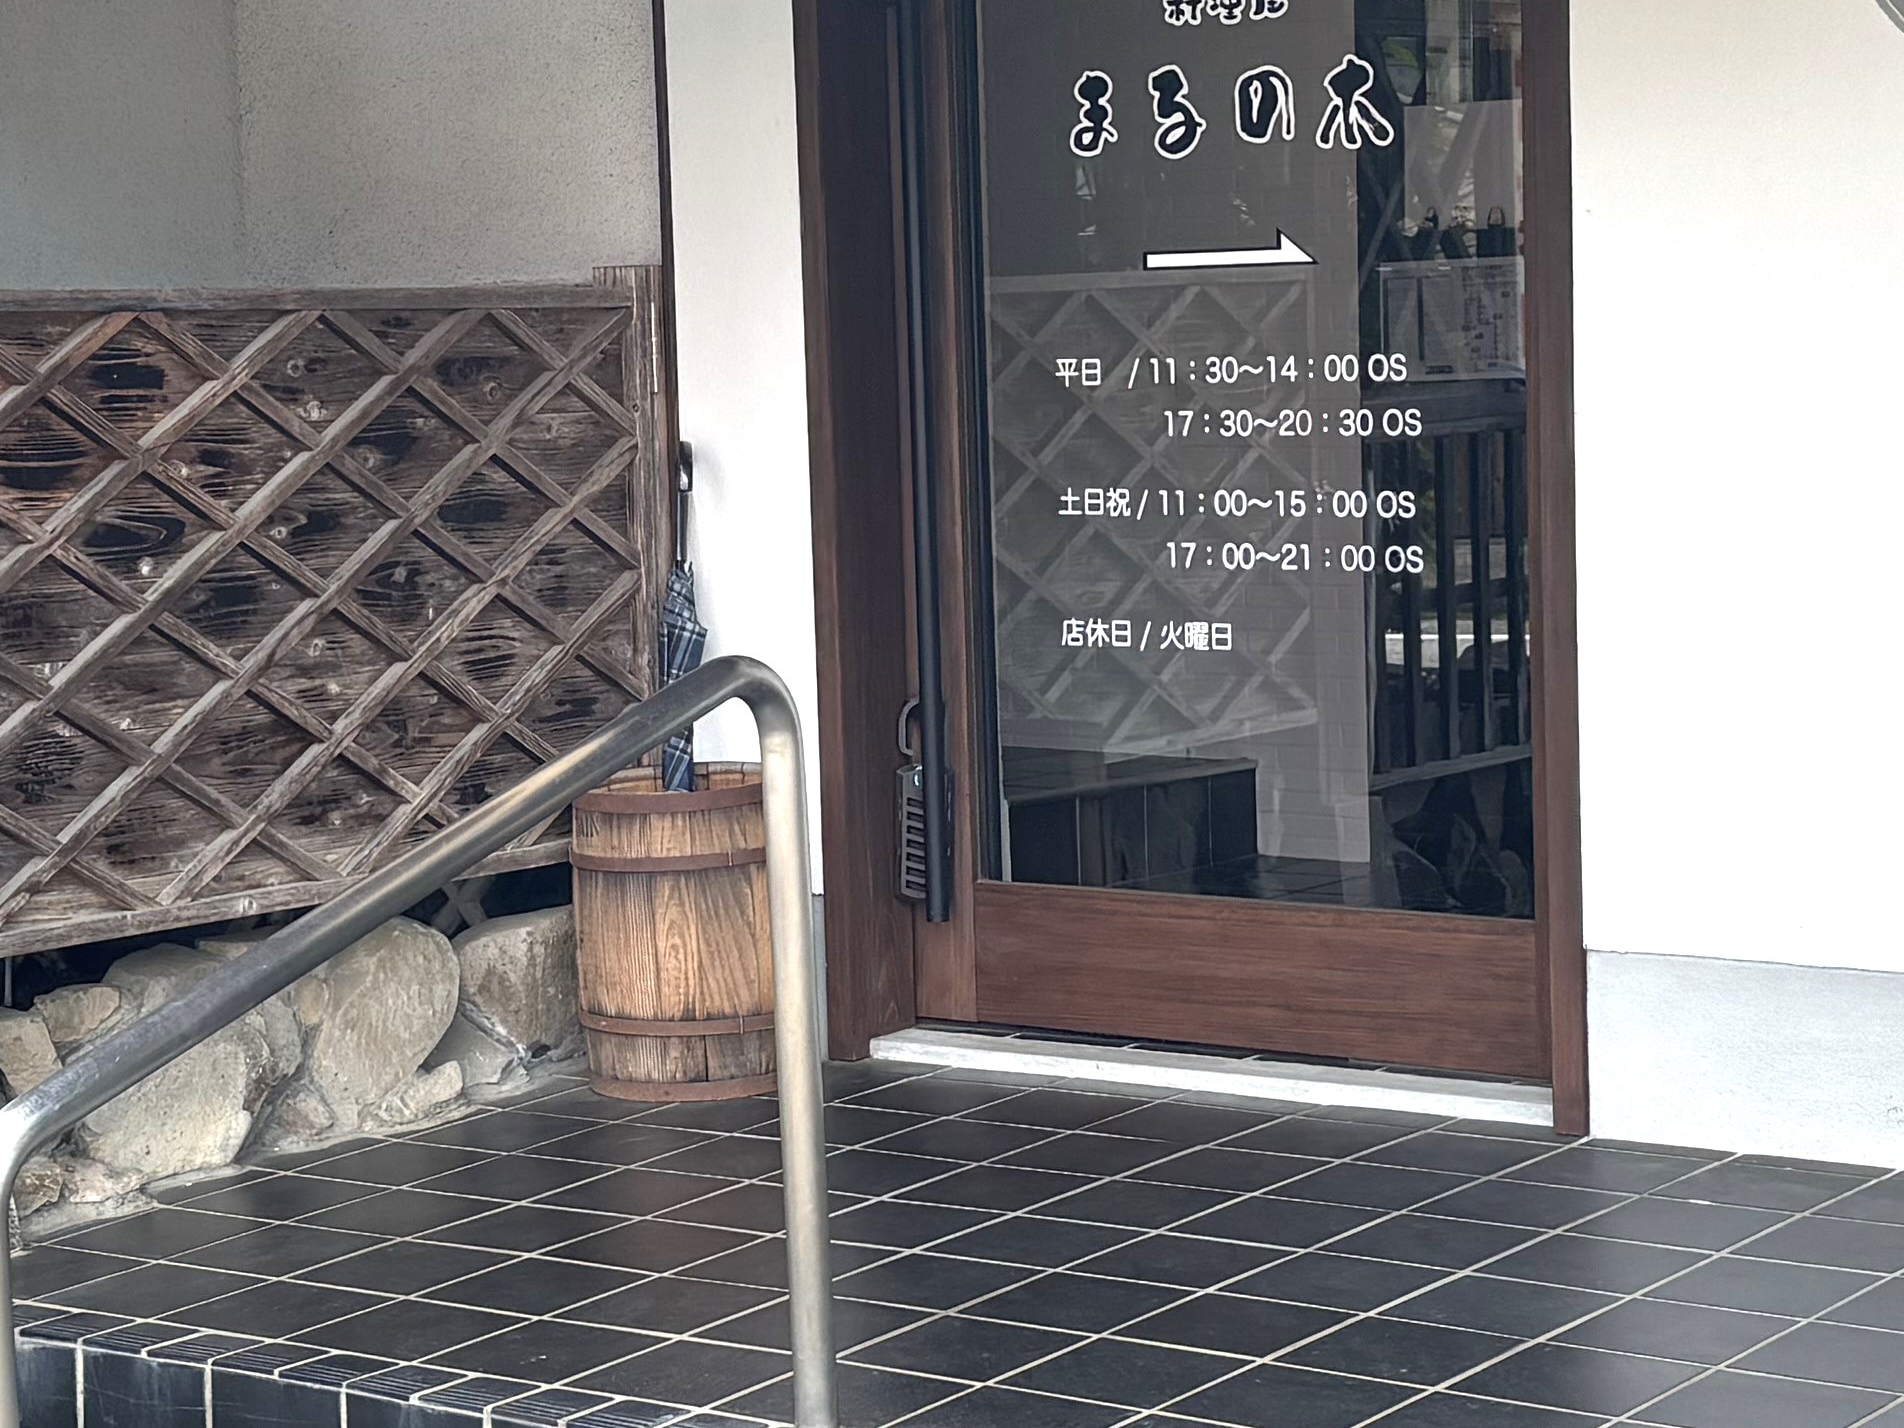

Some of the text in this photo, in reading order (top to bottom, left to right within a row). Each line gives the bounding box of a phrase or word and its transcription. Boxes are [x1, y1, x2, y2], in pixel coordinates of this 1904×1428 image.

[1070, 54, 1394, 159] まるの木
[1055, 357, 1102, 388] 平日
[1367, 353, 1408, 382] OS
[1382, 408, 1423, 437] OS
[1376, 489, 1417, 519] OS
[1384, 544, 1425, 574] OS
